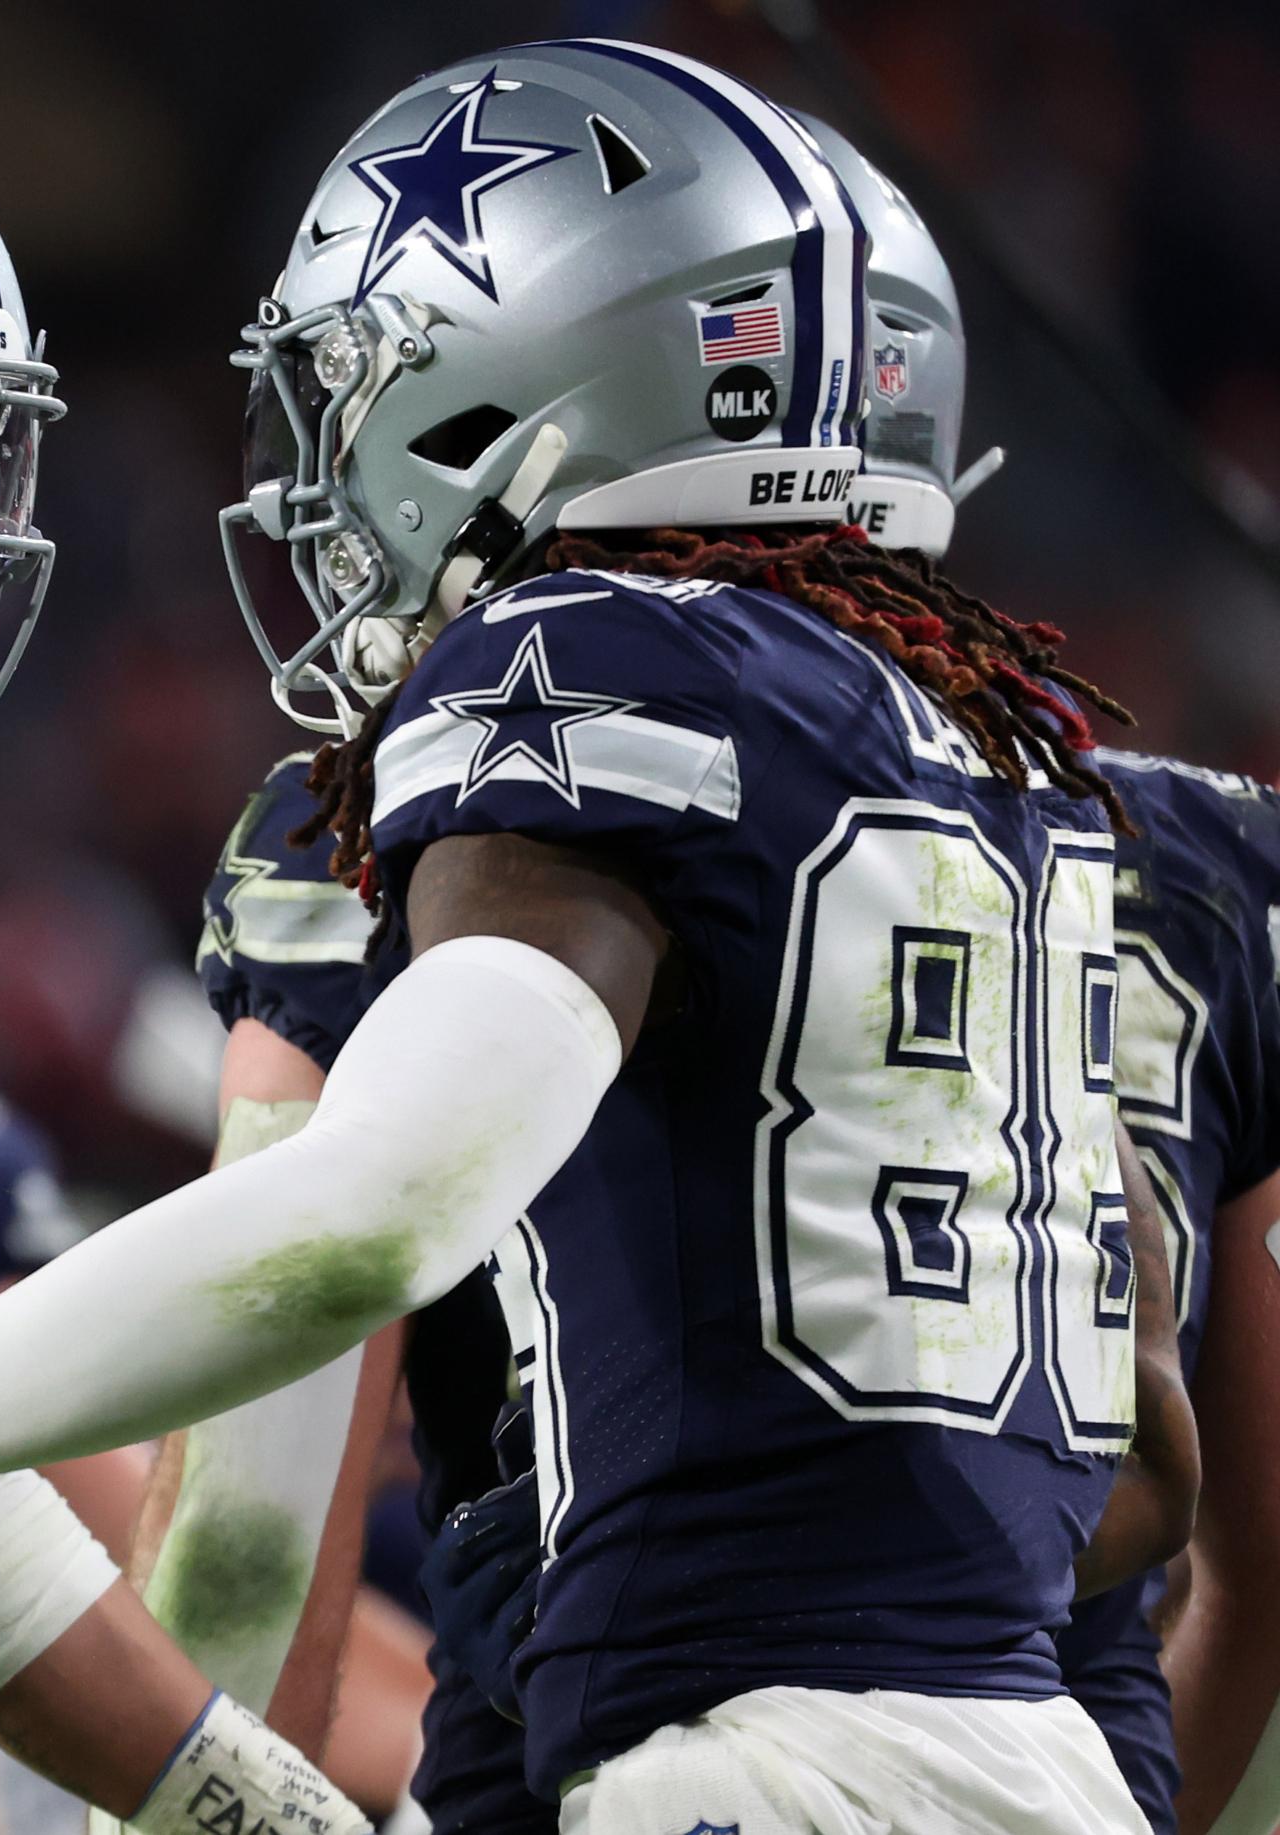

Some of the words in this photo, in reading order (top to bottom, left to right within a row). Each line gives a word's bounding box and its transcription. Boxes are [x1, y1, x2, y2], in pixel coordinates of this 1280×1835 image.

[878, 366, 906, 392] NFL
[711, 389, 771, 419] MLK
[749, 470, 798, 506] BE
[801, 469, 857, 502] LOVE
[846, 501, 889, 534] VE
[754, 797, 1137, 1455] 88
